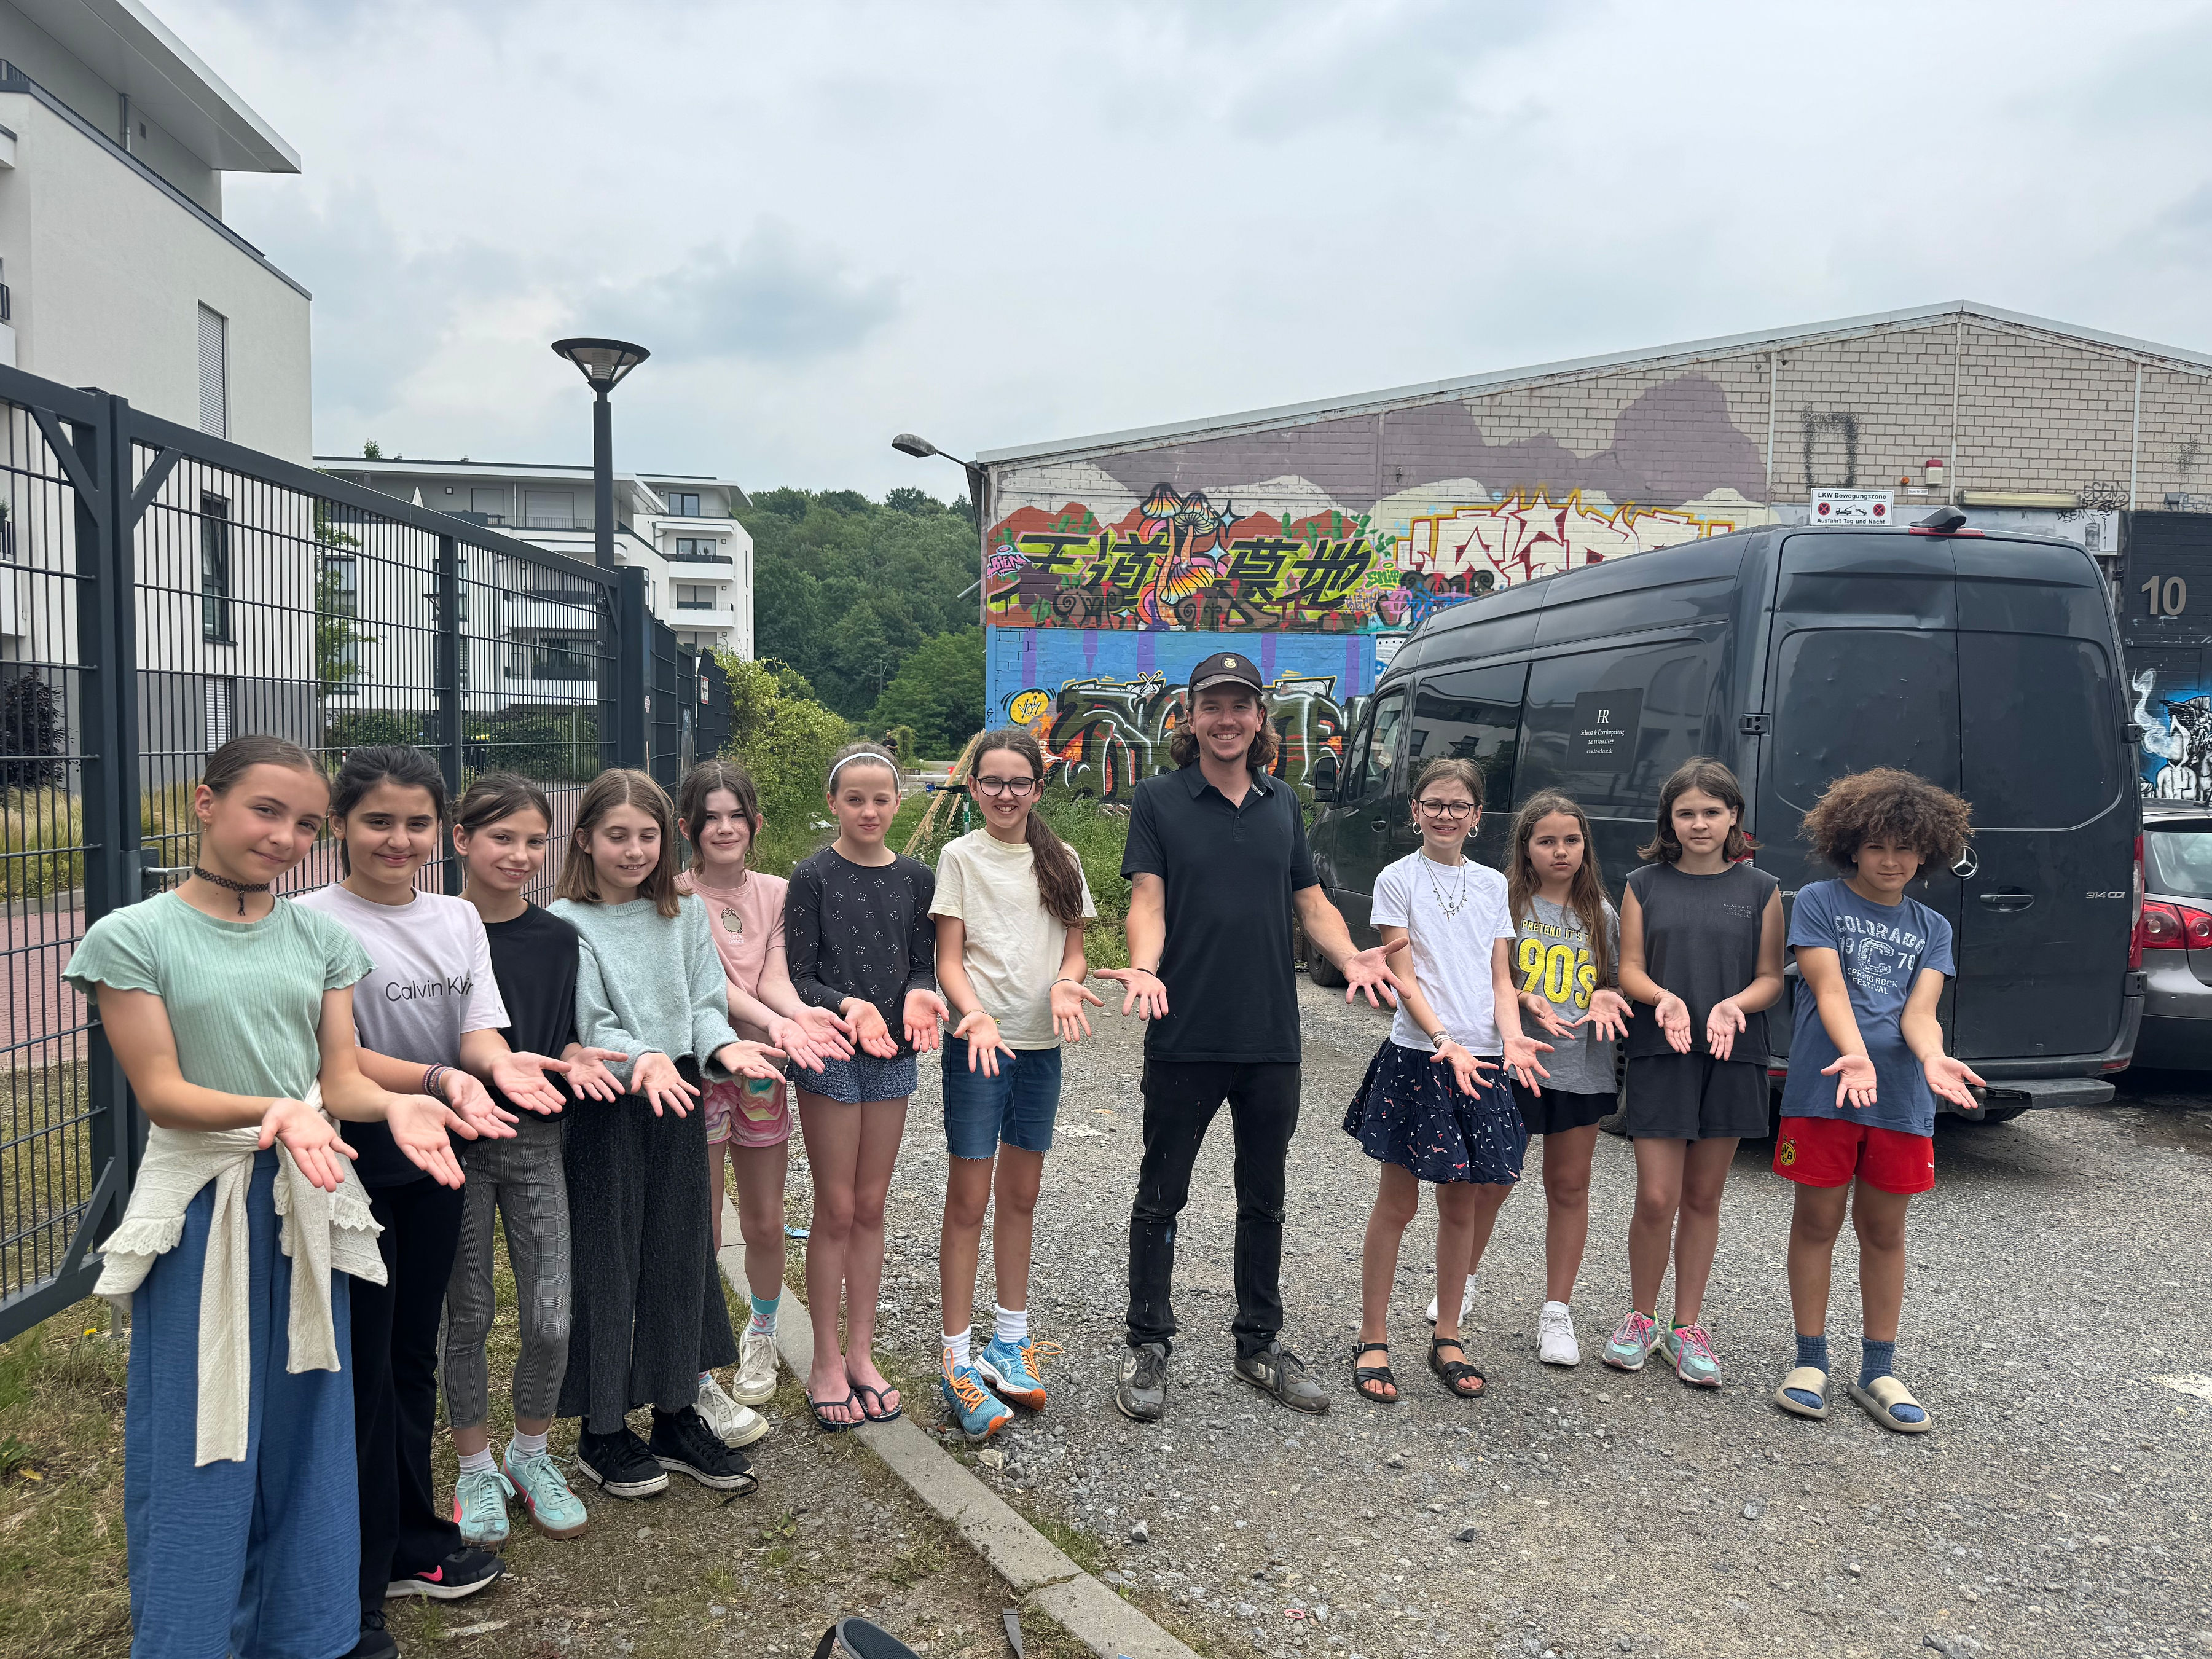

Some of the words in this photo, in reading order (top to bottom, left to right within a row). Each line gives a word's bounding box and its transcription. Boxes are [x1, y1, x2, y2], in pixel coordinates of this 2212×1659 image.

[2141, 575, 2186, 615] 10
[1596, 709, 1609, 724] HR
[1521, 919, 1561, 938] PRETEND
[1564, 927, 1582, 942] IT'S
[1838, 936, 1854, 954] 19
[1857, 937, 1894, 976] C
[1847, 968, 1875, 982] SPRING
[1875, 978, 1898, 987] ROCK
[1853, 977, 1889, 995] FESTIVAL
[385, 980, 443, 1002] Calvin
